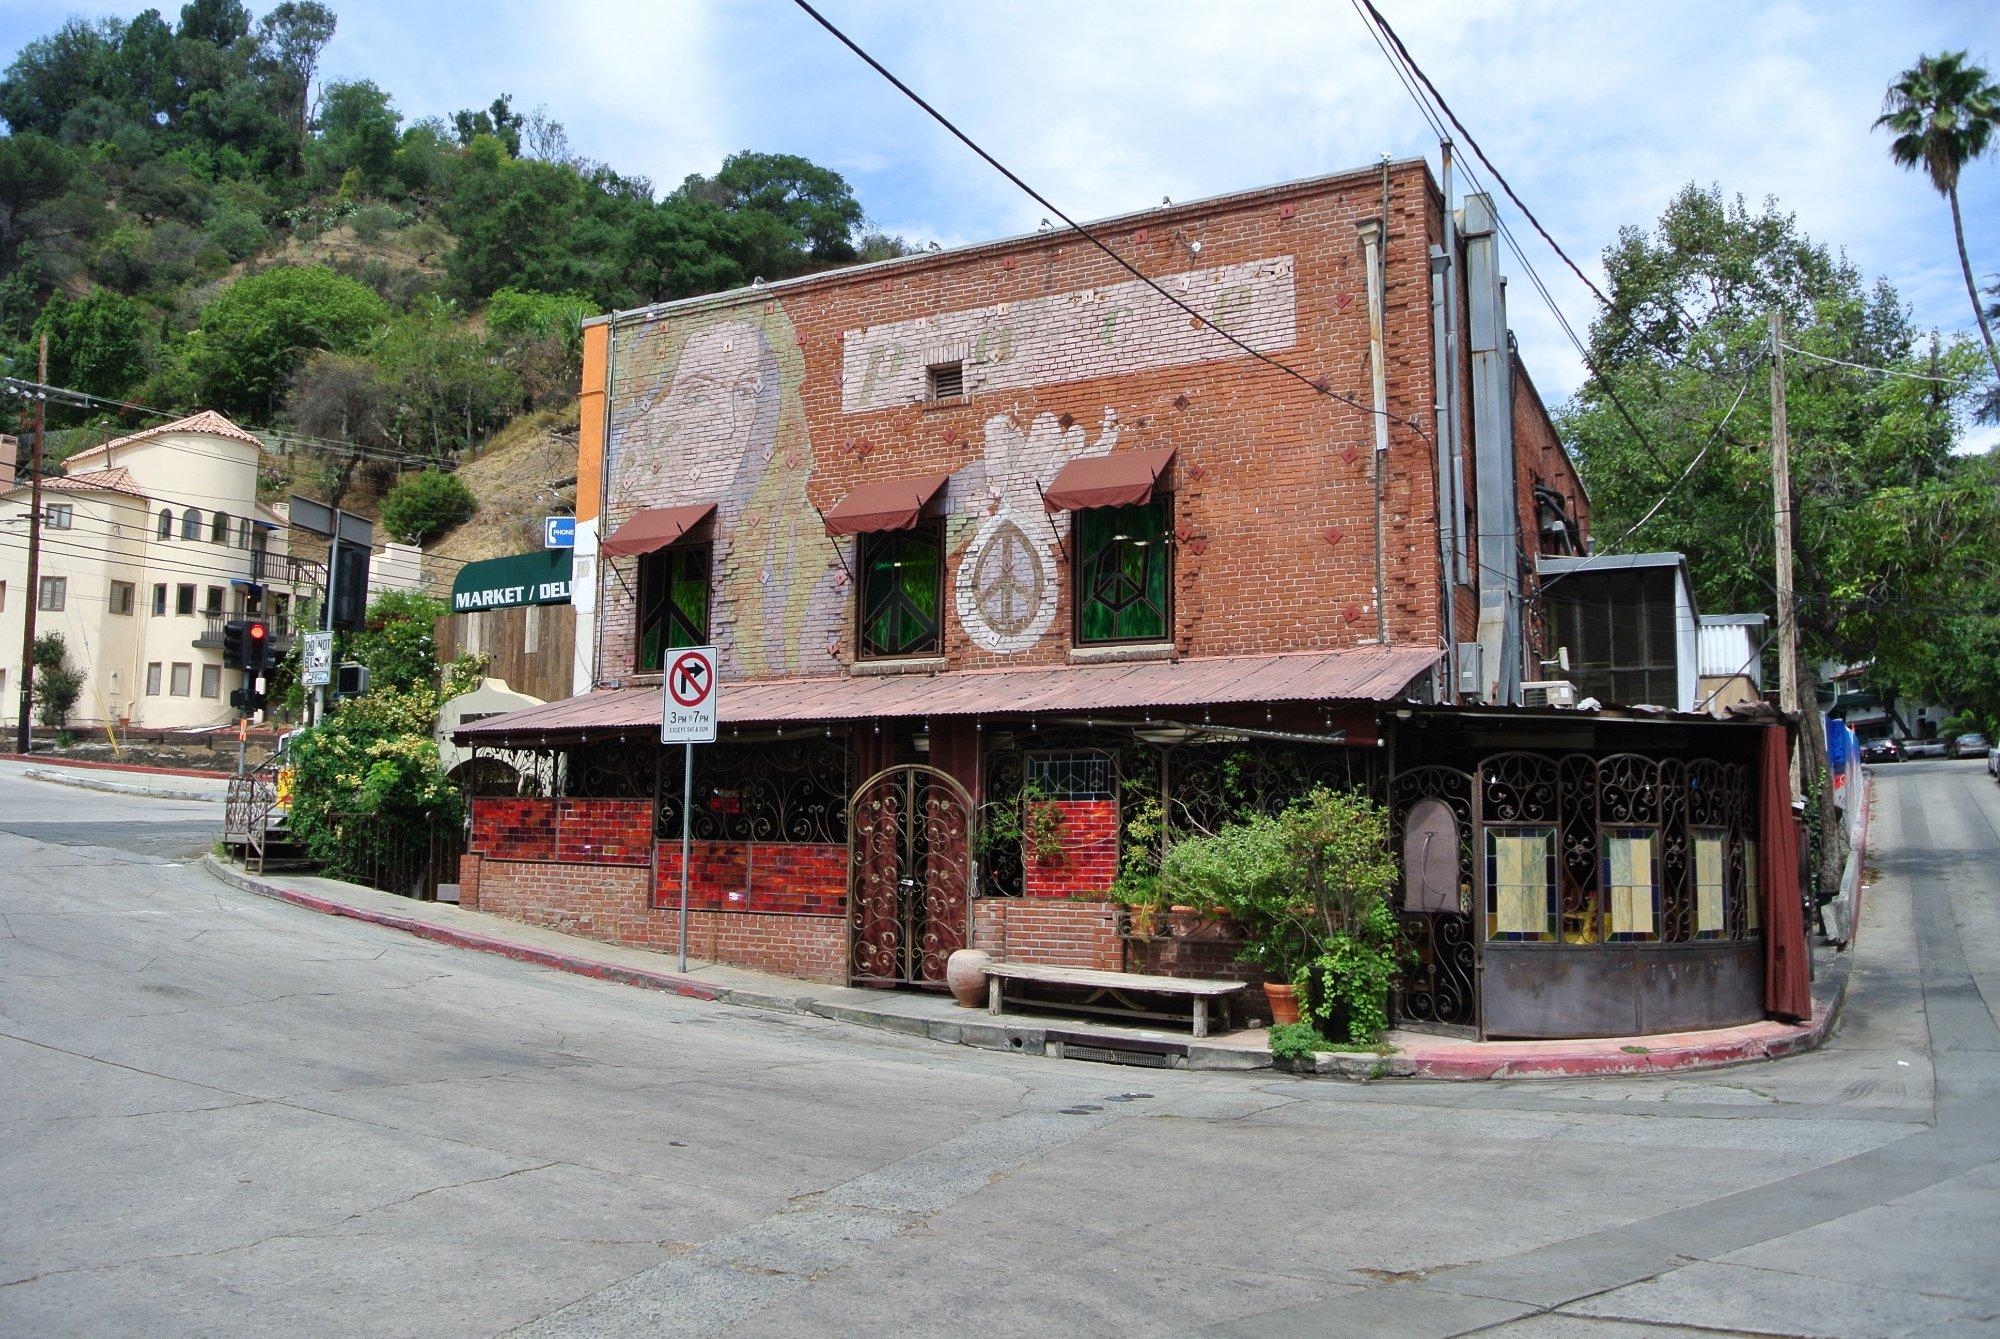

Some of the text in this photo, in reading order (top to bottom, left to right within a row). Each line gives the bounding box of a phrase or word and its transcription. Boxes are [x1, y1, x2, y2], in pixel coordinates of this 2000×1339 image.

[456, 586, 524, 608] MARKET
[529, 585, 534, 600] /
[306, 639, 331, 651] DO NOT
